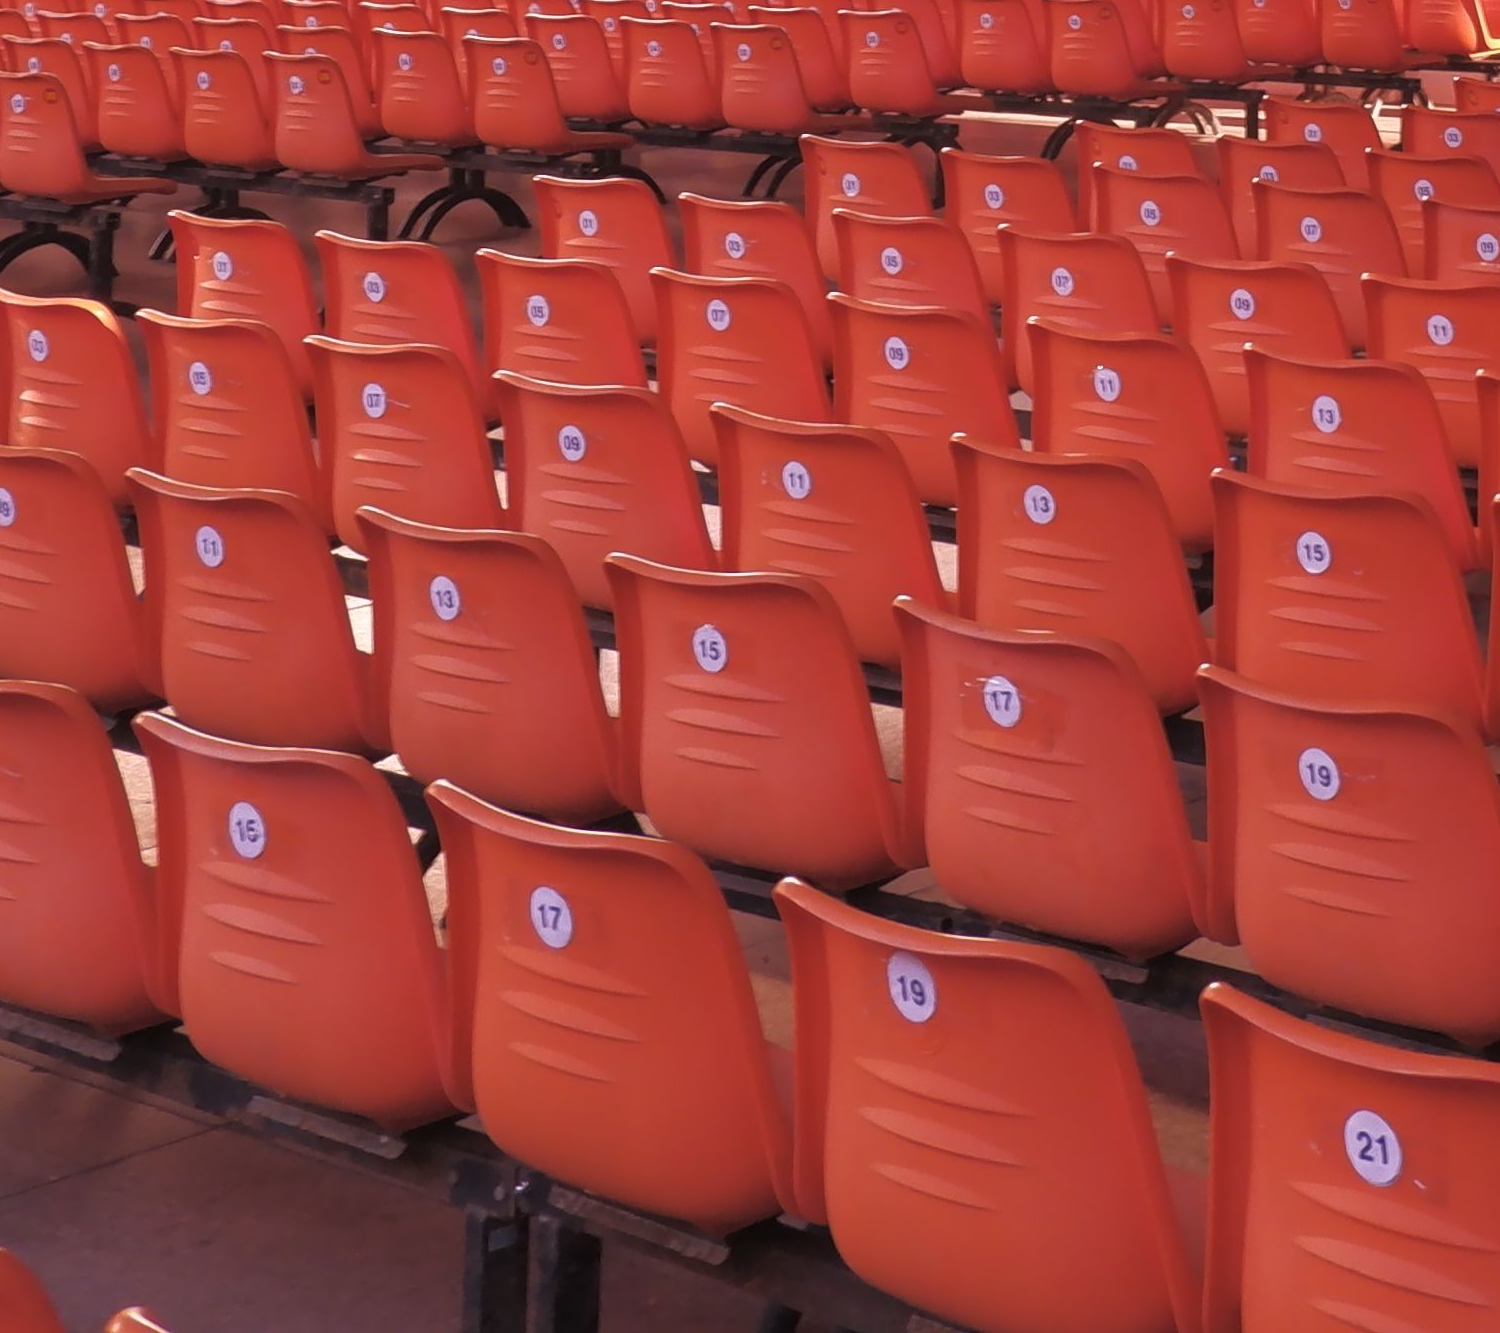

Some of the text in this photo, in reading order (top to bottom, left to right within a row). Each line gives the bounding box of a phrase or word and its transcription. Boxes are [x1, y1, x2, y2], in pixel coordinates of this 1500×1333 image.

[1235, 298, 1250, 311] 09
[712, 309, 726, 322] 07
[1433, 325, 1447, 336] 11
[889, 347, 904, 361] 09
[1100, 379, 1114, 392] 11
[367, 393, 382, 408] 07
[1319, 409, 1334, 424] 13
[564, 435, 581, 451] 09
[788, 473, 804, 489] 11
[1033, 496, 1050, 513] 13
[202, 538, 219, 557] 11
[1304, 544, 1325, 561] 15
[436, 590, 454, 608] 13
[700, 640, 720, 660] 15
[990, 691, 1012, 711] 17
[1306, 763, 1331, 787] 19
[538, 905, 561, 930] 17
[897, 976, 926, 1006] 19
[1357, 1131, 1388, 1164] 21
